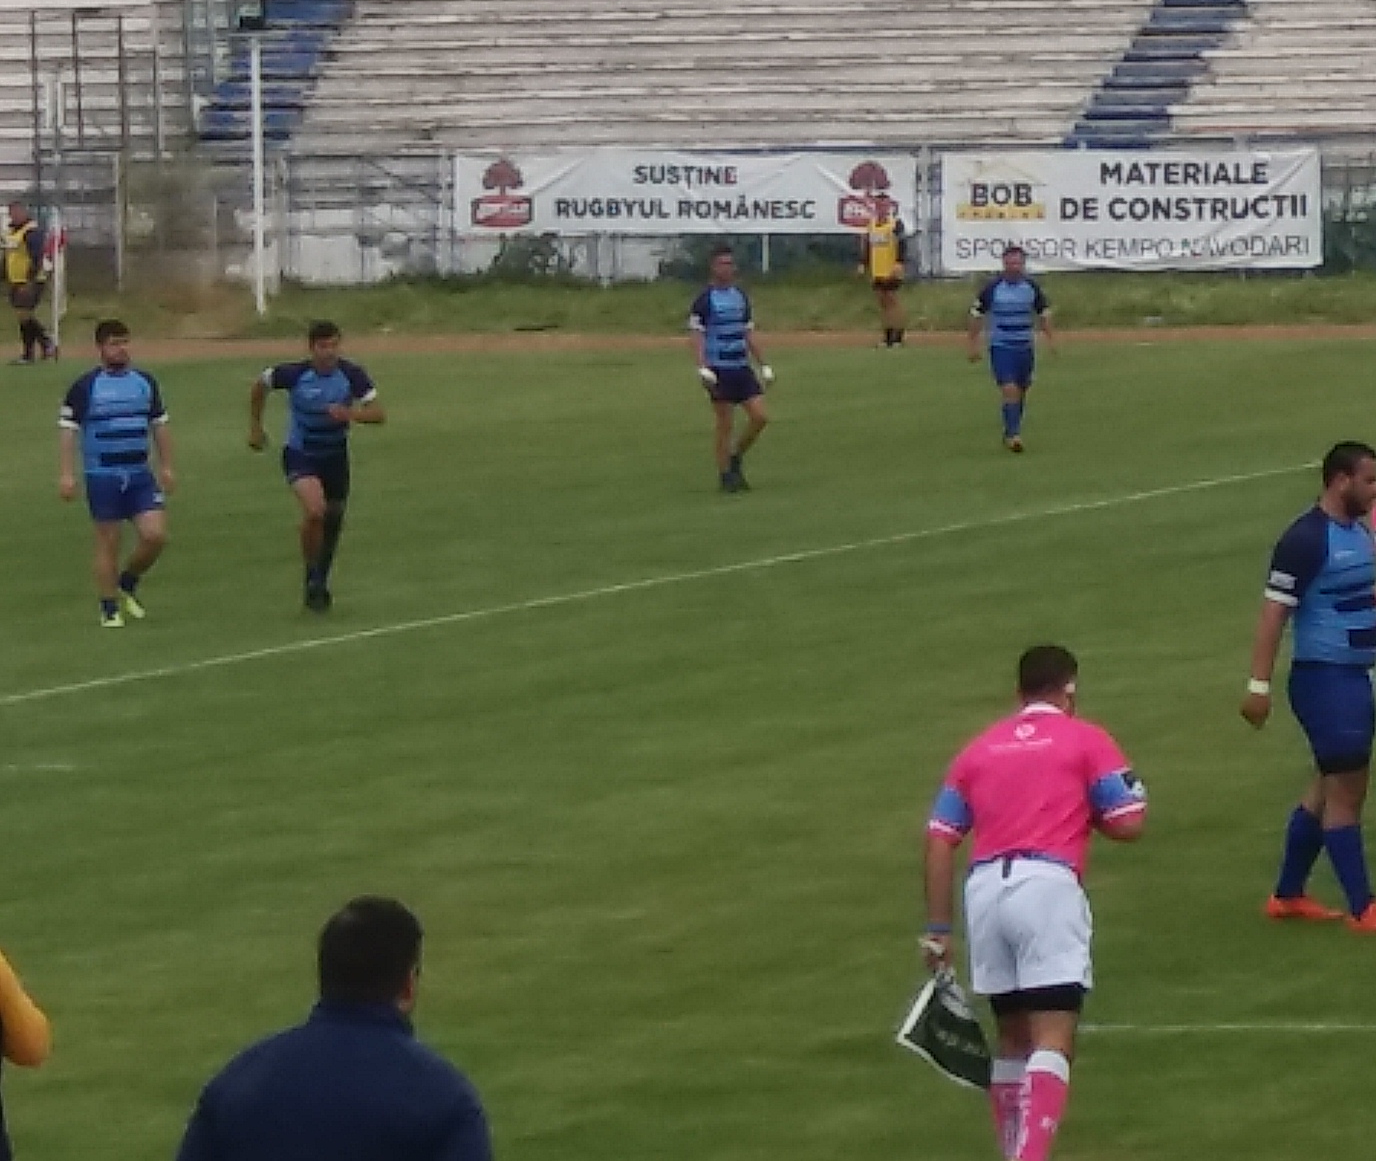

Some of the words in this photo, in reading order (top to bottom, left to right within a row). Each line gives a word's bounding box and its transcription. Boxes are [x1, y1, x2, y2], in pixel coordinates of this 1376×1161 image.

[1100, 161, 1270, 185] MATERIALE
[971, 183, 1032, 207] BOB
[554, 198, 670, 219] RUGBYUL
[1060, 197, 1099, 220] DE
[1086, 237, 1173, 259] KEMPO
